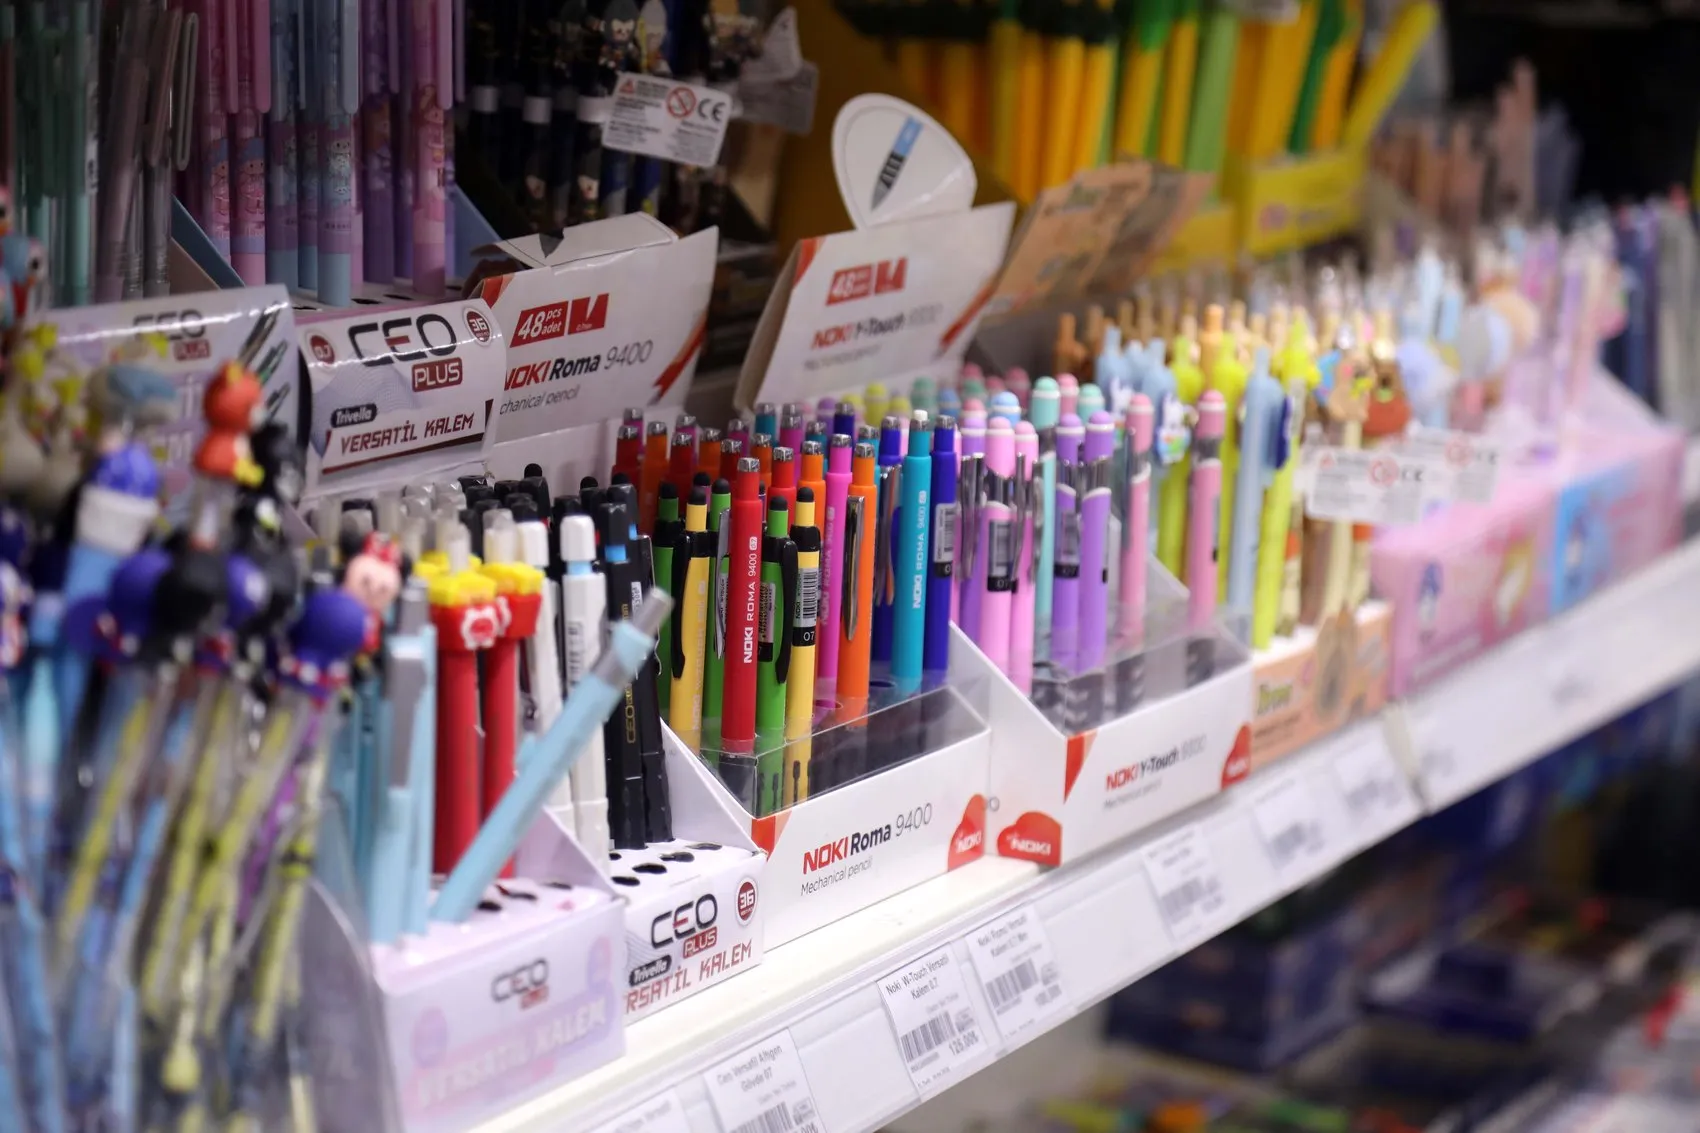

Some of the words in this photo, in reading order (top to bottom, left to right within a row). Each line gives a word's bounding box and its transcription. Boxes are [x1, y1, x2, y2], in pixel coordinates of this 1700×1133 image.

[468, 317, 488, 332] 36
[518, 311, 546, 340] 48
[541, 321, 562, 335] adet
[545, 307, 563, 322] pcs
[348, 313, 457, 367] CEO
[413, 361, 462, 388] PLUS
[550, 354, 601, 381] Roma
[604, 340, 654, 370] 9400
[500, 391, 546, 415] chanical
[341, 419, 418, 456] VERSATİL
[424, 412, 474, 439] KALEM
[748, 553, 758, 577] 9400
[746, 581, 756, 621] ROMA
[743, 627, 754, 664] NOKI
[626, 705, 636, 744] CEO
[1138, 746, 1180, 778] Y-Touch
[802, 836, 849, 874] NOKI
[849, 823, 892, 856] Roma
[895, 803, 933, 839] 9400
[957, 829, 983, 853] NOKI
[800, 867, 848, 896] Mechanical
[847, 857, 873, 879] pencil
[739, 889, 755, 909] 36
[651, 893, 718, 949] CEO
[684, 930, 717, 958] PLUS
[492, 958, 549, 1003] CEO
[626, 965, 691, 1015] RSATİL
[699, 939, 752, 982] KALEM
[633, 959, 667, 984] Trivella
[885, 977, 902, 996] Noki
[901, 966, 928, 987] W-Touch
[910, 983, 931, 1001] Kalem
